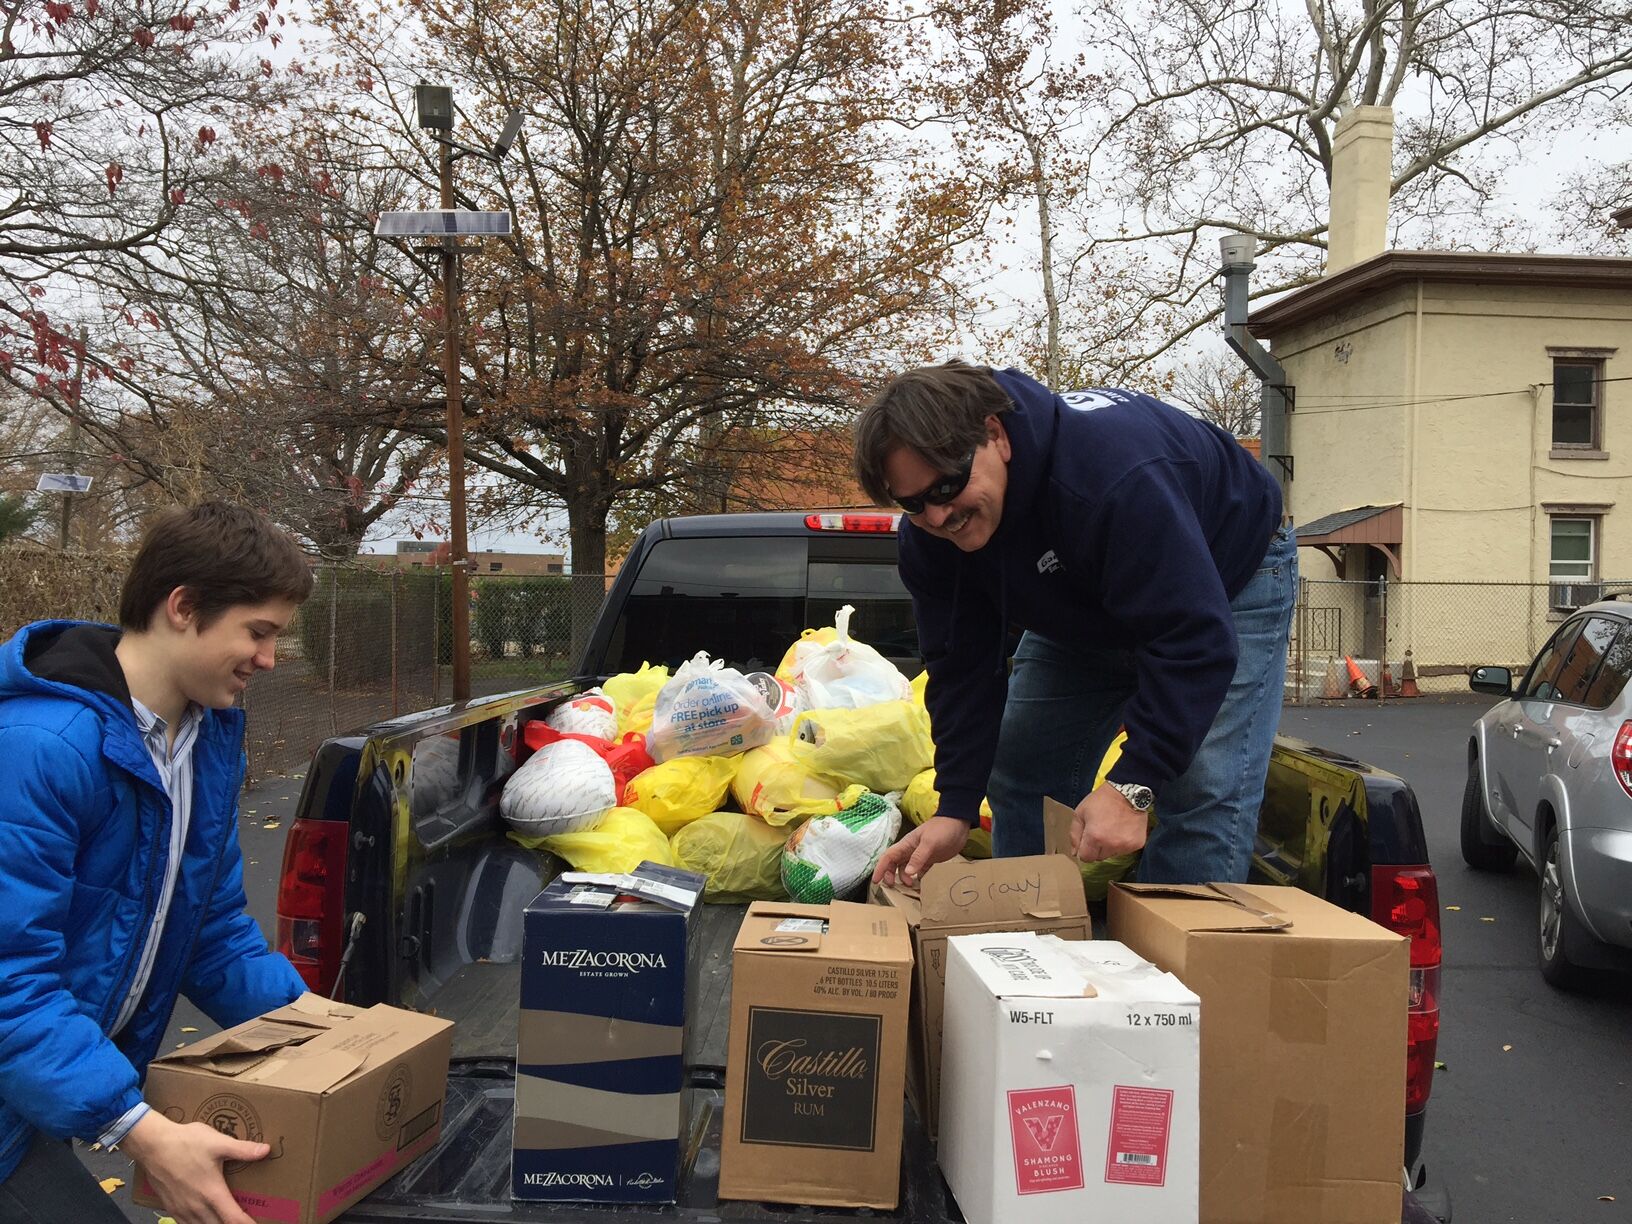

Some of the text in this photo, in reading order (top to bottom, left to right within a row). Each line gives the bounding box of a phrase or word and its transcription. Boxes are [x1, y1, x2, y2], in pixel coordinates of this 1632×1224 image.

[673, 691, 733, 711] Order online
[671, 702, 739, 723] FREE pick up
[684, 723, 696, 733] at
[698, 717, 727, 729] store
[950, 872, 1042, 906] Gravy
[542, 949, 667, 974] MEZZACORONA
[827, 966, 855, 976] CASTILLO
[856, 968, 876, 978] SILVER
[877, 969, 889, 979] 1.75
[825, 976, 836, 985] PET
[837, 977, 863, 987] BOTTLES
[865, 979, 877, 988] 10.5
[878, 980, 899, 989] LITERS
[813, 985, 826, 995] 40%
[827, 986, 840, 996] ALC.
[842, 987, 850, 996] BY
[878, 990, 897, 999] PROOF
[1010, 1010, 1054, 1025] W5-FLT
[1126, 1013, 1141, 1026] 12
[1154, 1013, 1176, 1026] 750
[1178, 1013, 1192, 1026] ml
[757, 1039, 868, 1080] Castillo
[786, 1077, 835, 1098] Silver
[230, 1100, 256, 1130] OWNED
[793, 1102, 825, 1116] RUM
[1015, 1099, 1070, 1115] VALENZANO
[1024, 1153, 1073, 1166] SHAMONG
[1033, 1167, 1065, 1177] BLUSH
[523, 1172, 614, 1190] MEZZACORONA
